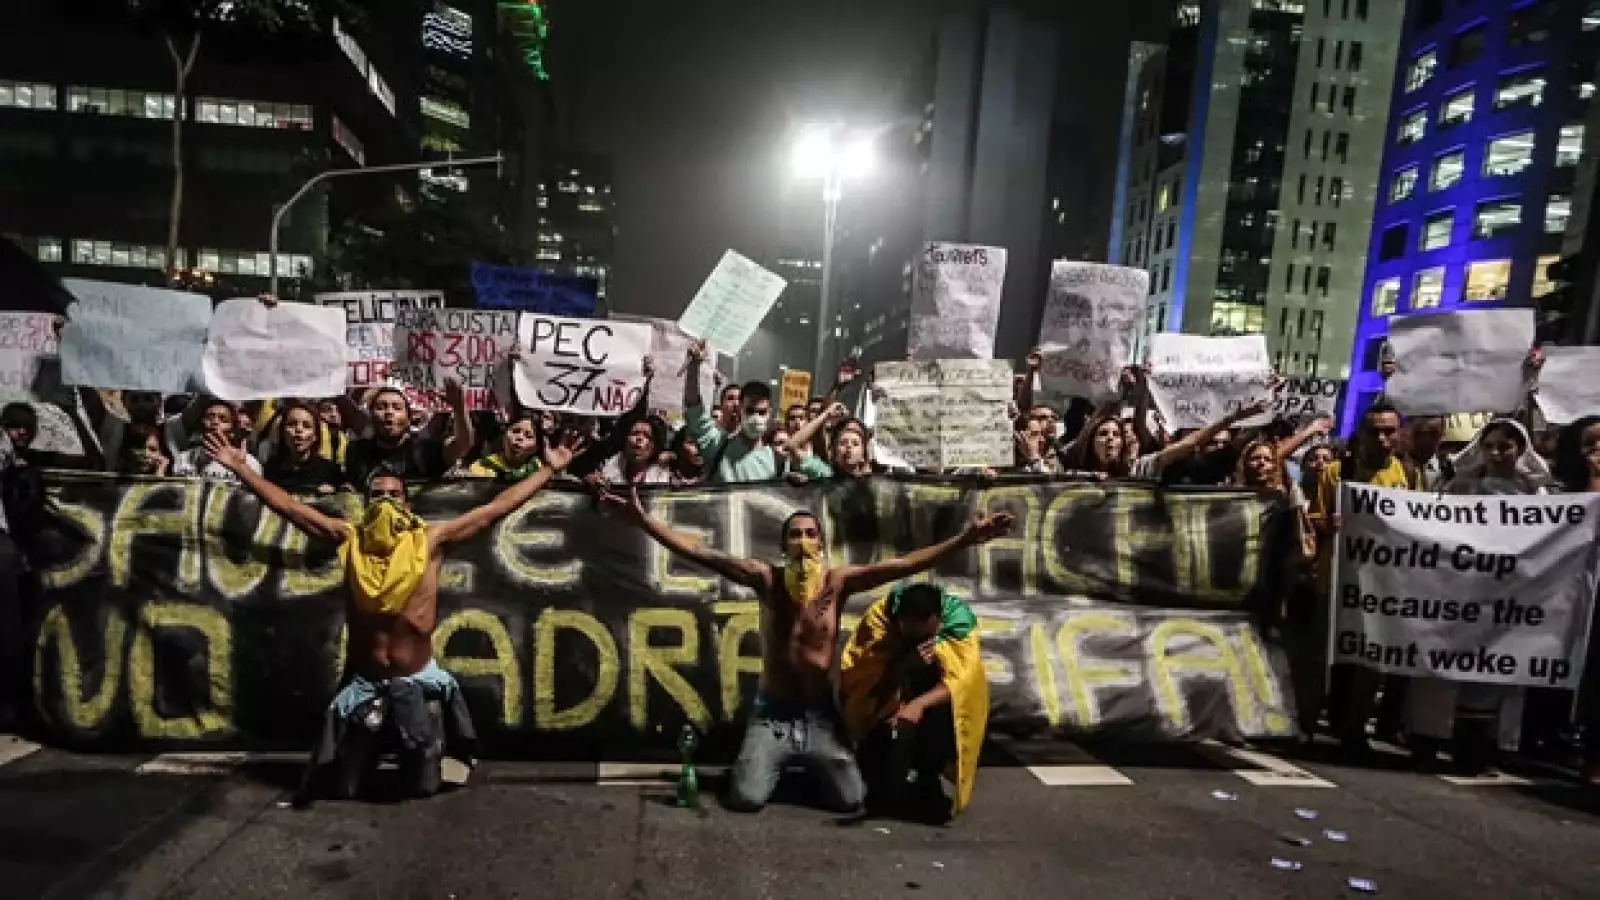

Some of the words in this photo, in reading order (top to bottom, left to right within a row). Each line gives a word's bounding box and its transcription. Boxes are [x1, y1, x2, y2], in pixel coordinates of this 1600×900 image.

[448, 311, 513, 336] CUSTA
[530, 318, 613, 364] PEC
[455, 363, 497, 388] SER
[536, 361, 606, 407] 37
[592, 379, 643, 412] NÃO
[1350, 488, 1396, 516] We
[1407, 501, 1488, 525] wont
[1500, 500, 1587, 525] have
[42, 480, 472, 598] SAUD
[492, 488, 585, 590] E
[1346, 536, 1440, 569] World
[1451, 544, 1516, 580] Cup
[1343, 584, 1480, 624] Because
[1492, 598, 1545, 626] the
[33, 602, 236, 738] NO
[335, 600, 862, 735] ADRÃ
[1337, 630, 1419, 668] Giant
[1428, 645, 1517, 675] woke
[1529, 655, 1571, 685] up
